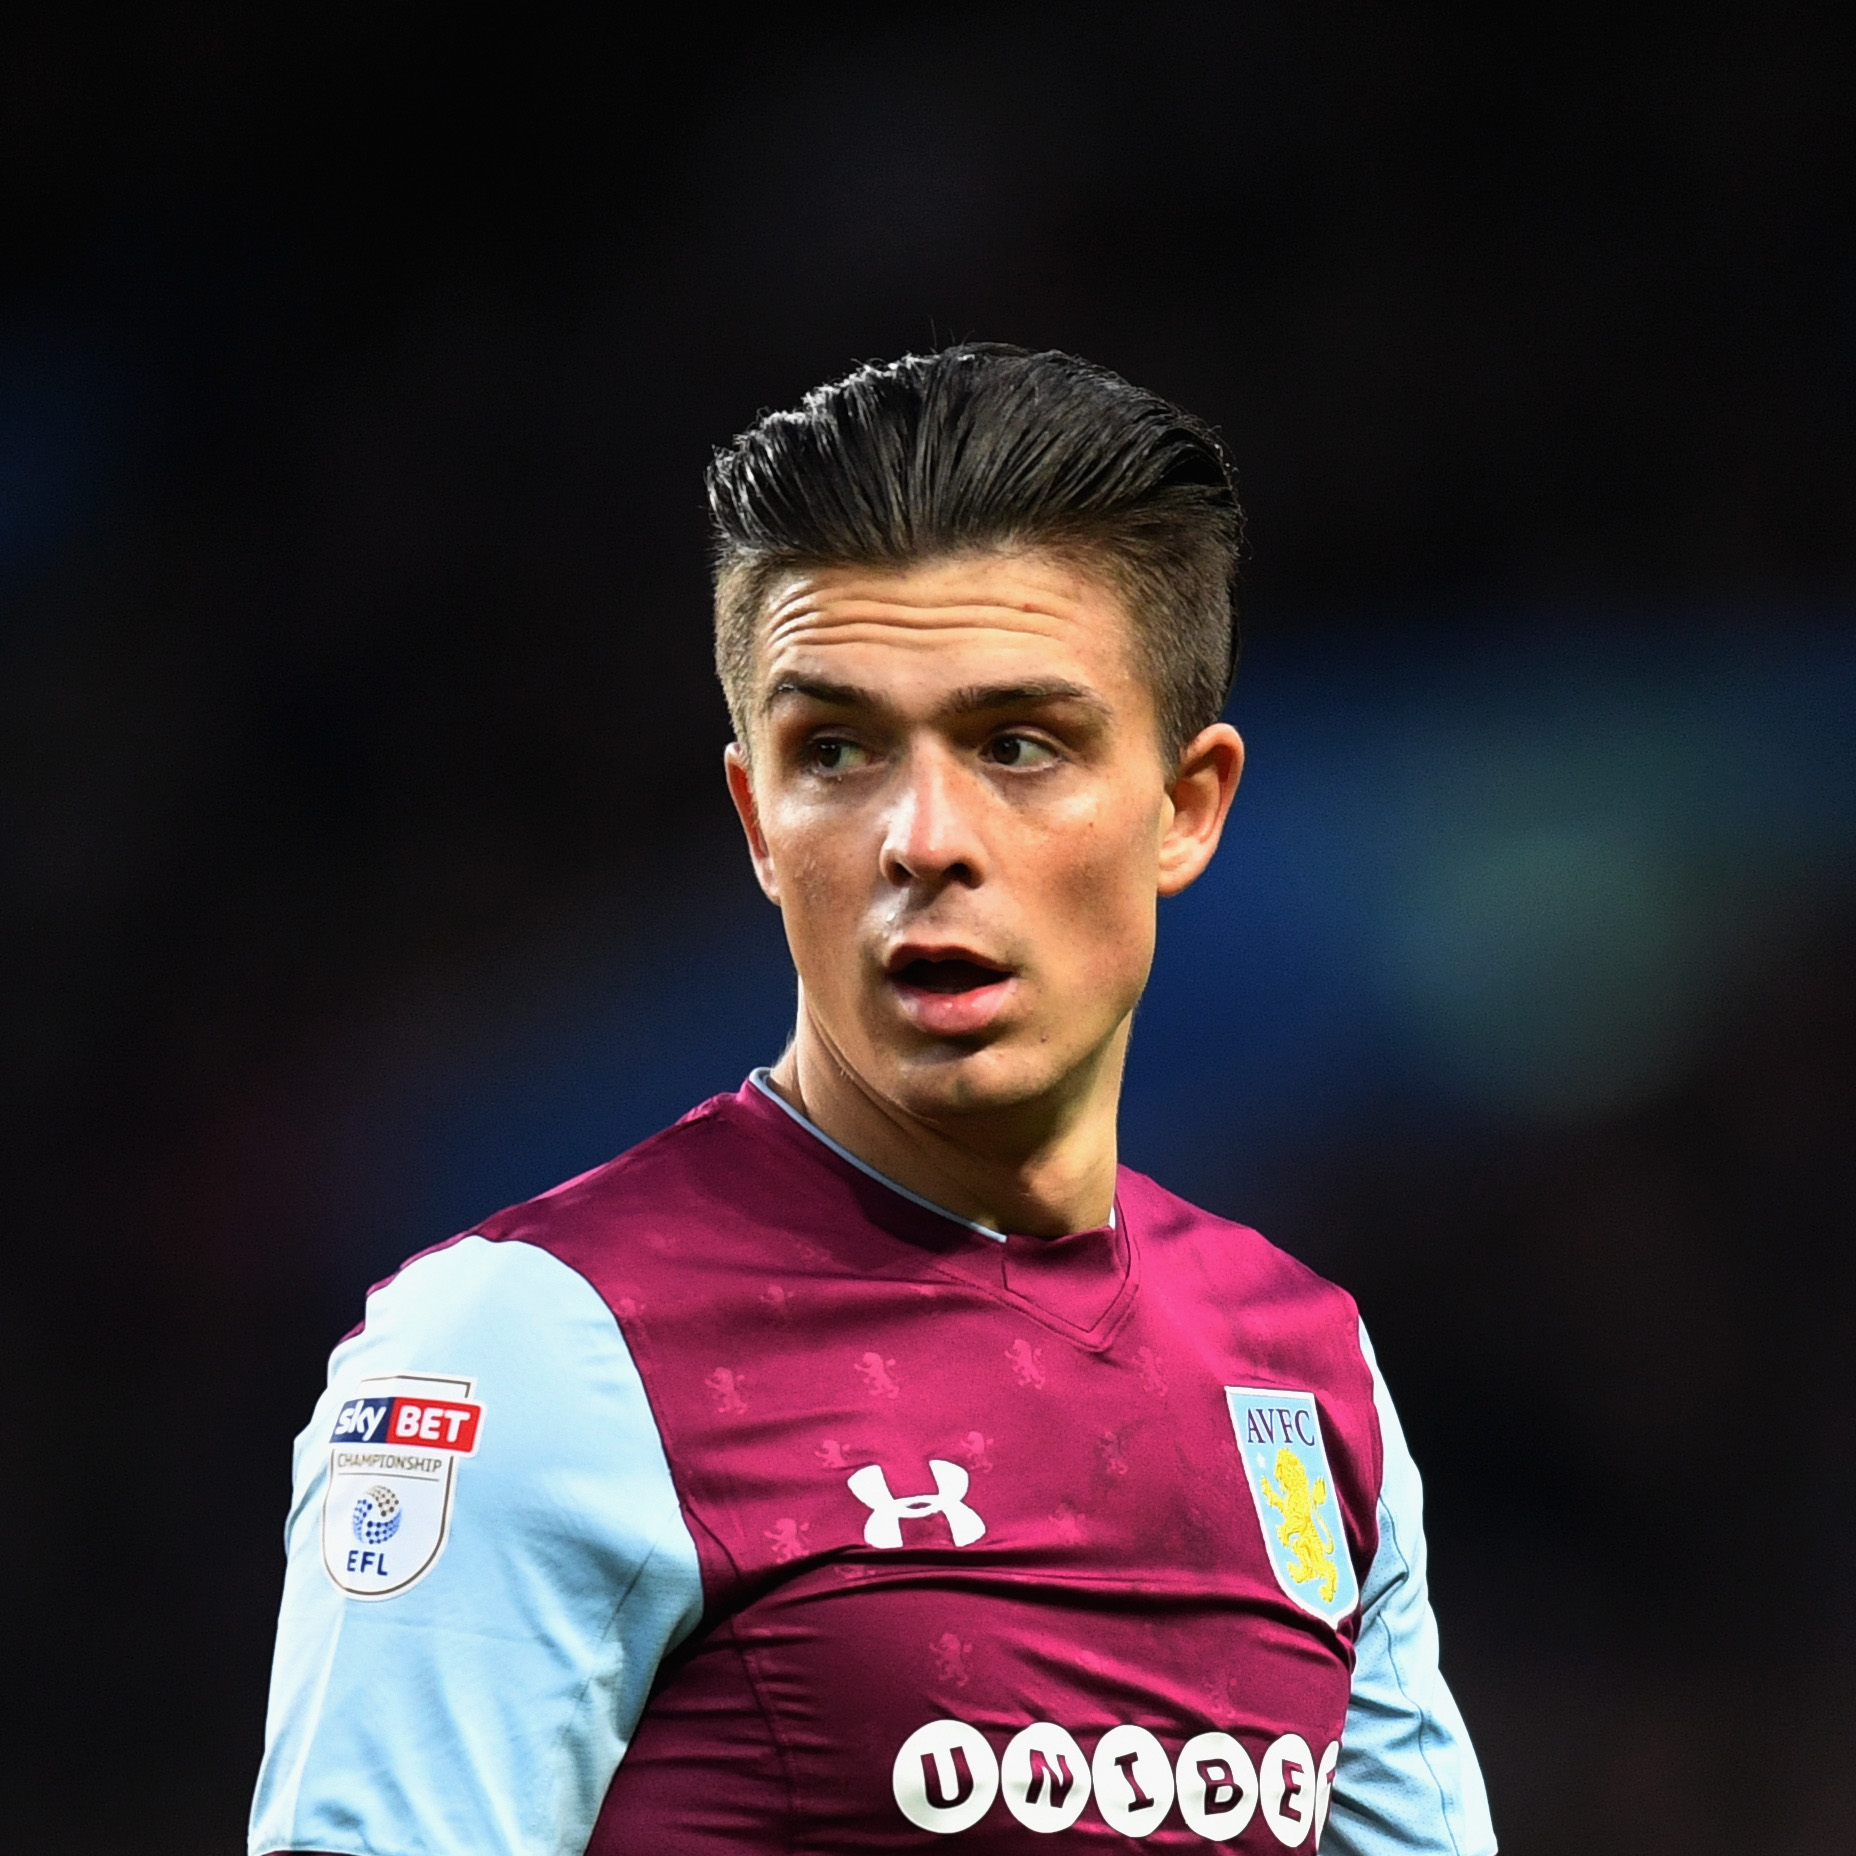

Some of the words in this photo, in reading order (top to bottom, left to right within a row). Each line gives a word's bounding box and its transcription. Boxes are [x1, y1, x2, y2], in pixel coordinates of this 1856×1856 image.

[334, 1399, 387, 1442] sky
[395, 1404, 472, 1443] BET
[1247, 1407, 1316, 1447] AVFC
[337, 1452, 443, 1473] CHAMPIONSHIP
[346, 1549, 389, 1577] EFL
[915, 1741, 1339, 1829] UNIBE
